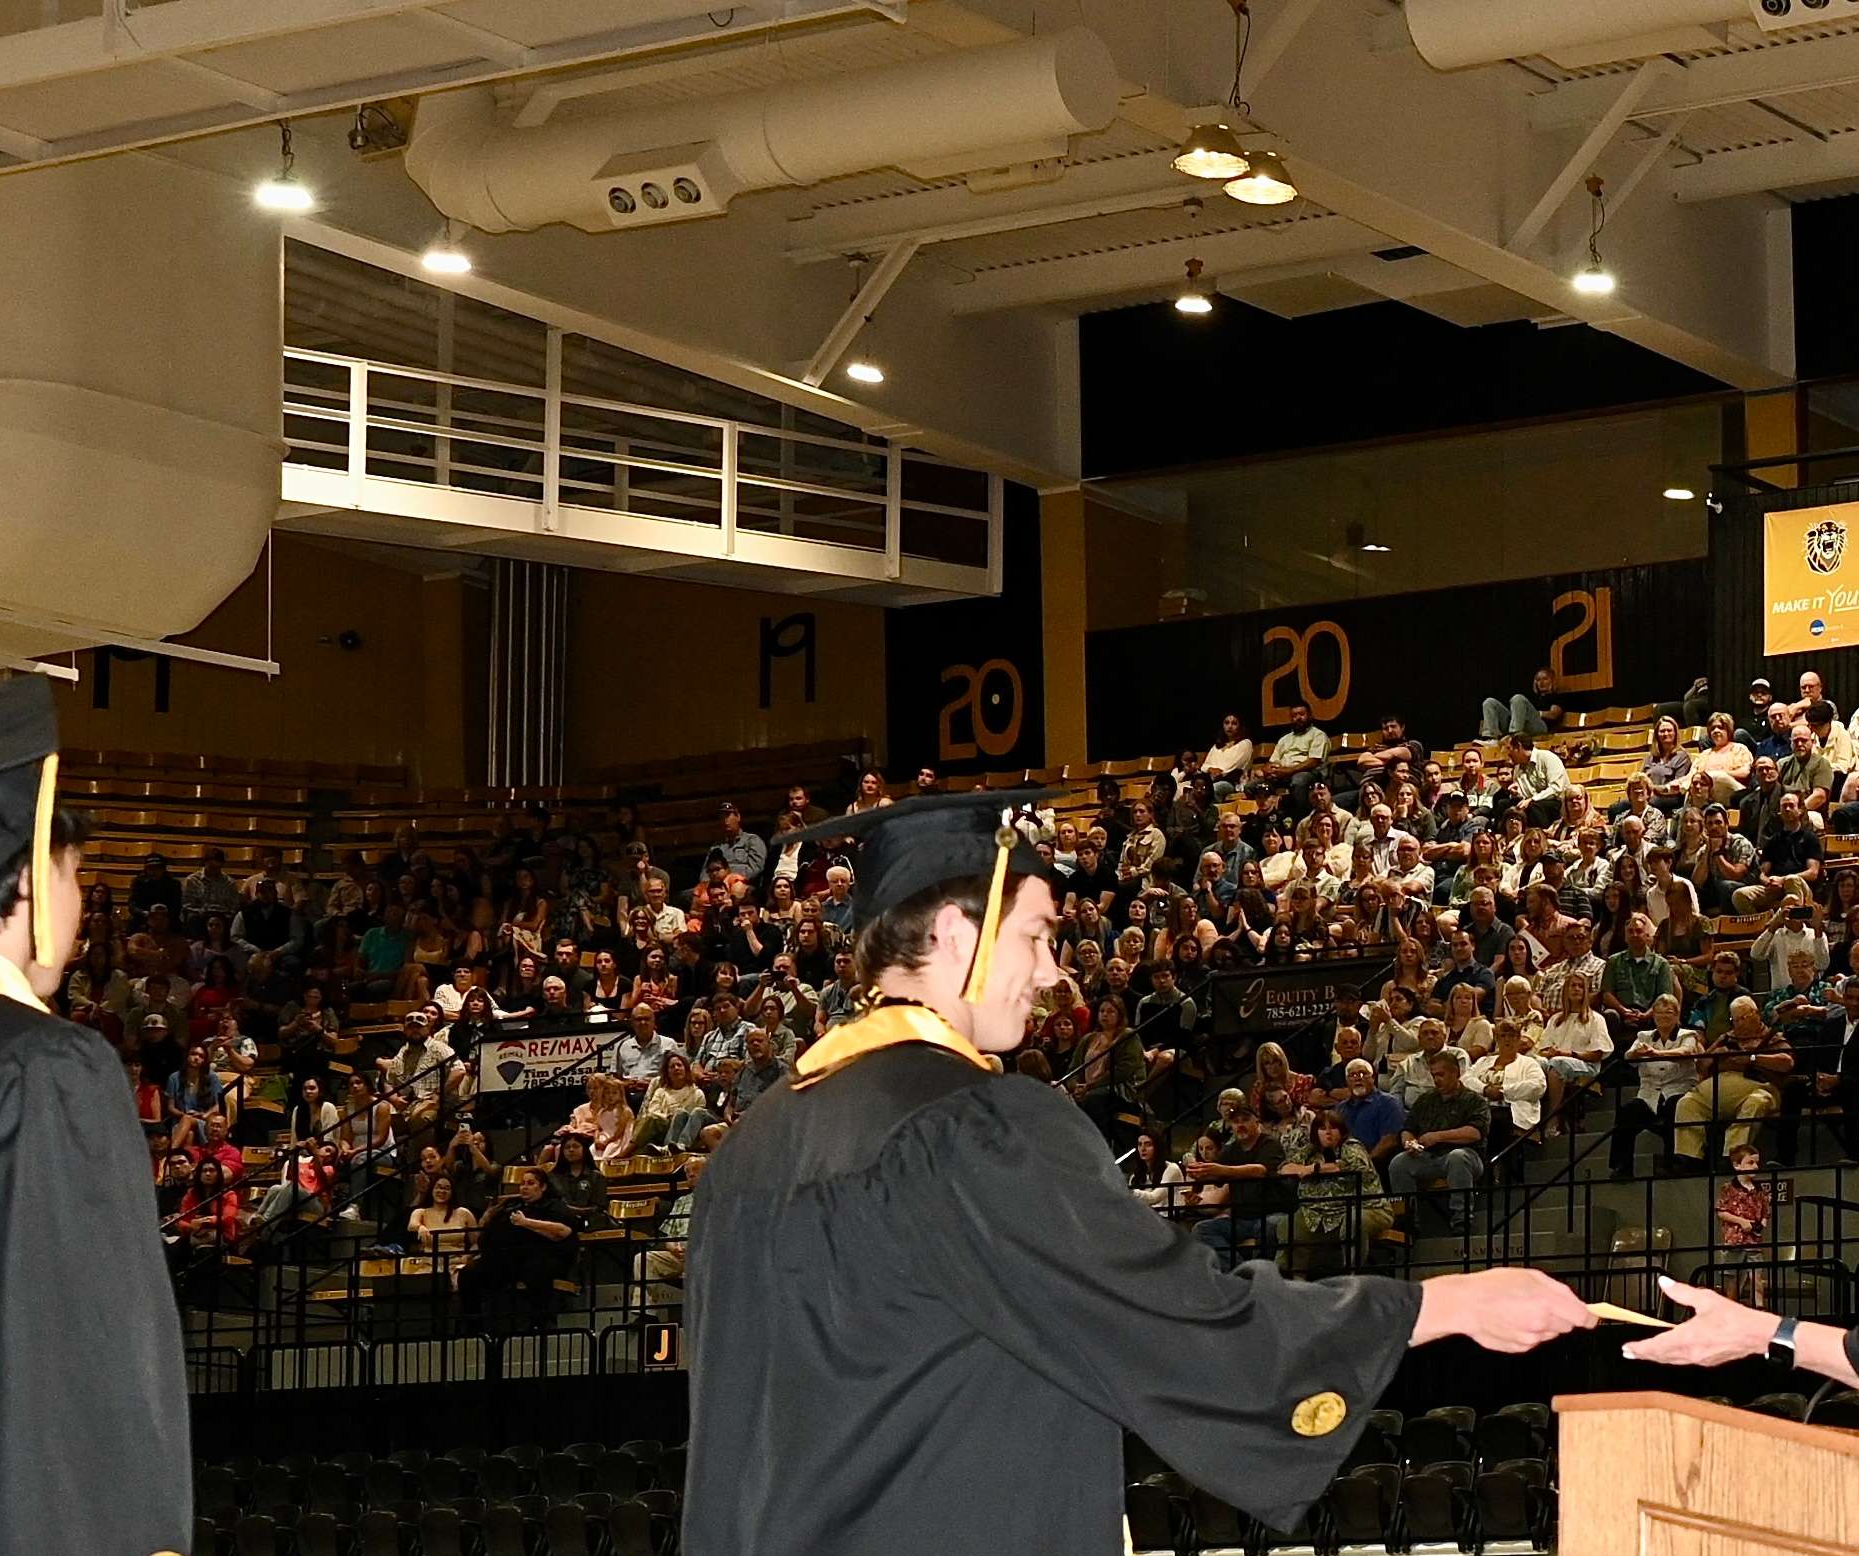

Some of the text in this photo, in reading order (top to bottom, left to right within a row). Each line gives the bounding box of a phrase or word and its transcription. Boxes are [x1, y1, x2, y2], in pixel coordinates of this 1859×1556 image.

[1772, 599, 1810, 614] MAKE
[1811, 597, 1826, 611] IT
[1550, 586, 1613, 695] 21
[1261, 620, 1351, 727] 20
[939, 658, 1024, 762] 20
[1265, 989, 1319, 1006] EQUITY
[528, 1037, 596, 1057] RE/MAX
[524, 1068, 549, 1079] Tim
[653, 1330, 668, 1361] J
